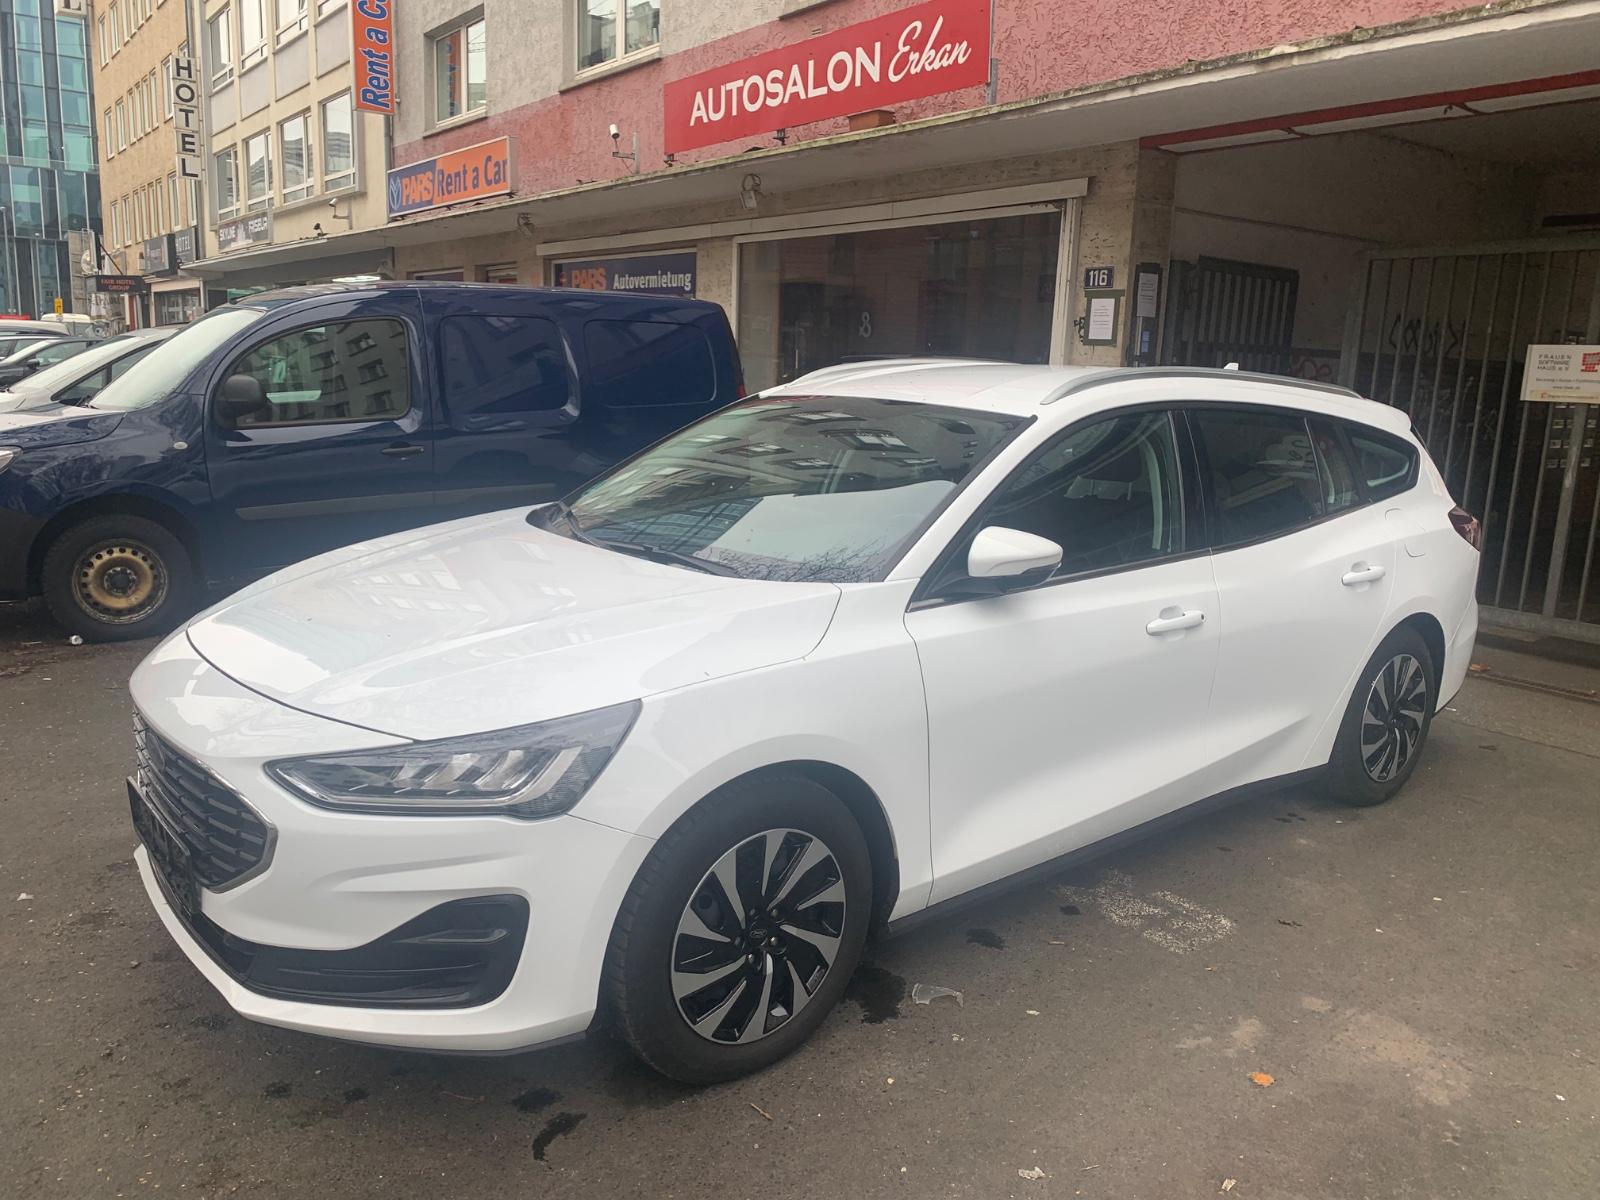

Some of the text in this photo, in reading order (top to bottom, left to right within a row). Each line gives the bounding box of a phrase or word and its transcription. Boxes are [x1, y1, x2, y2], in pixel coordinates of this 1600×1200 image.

[365, 27, 389, 45] a
[360, 48, 390, 109] Rent
[689, 15, 972, 127] AUTOSALON Erkan
[175, 58, 199, 178] HOTEL
[402, 155, 508, 207] PARS Rent a Car
[571, 266, 691, 291] PARS Autovermietung
[1089, 270, 1108, 287] 116
